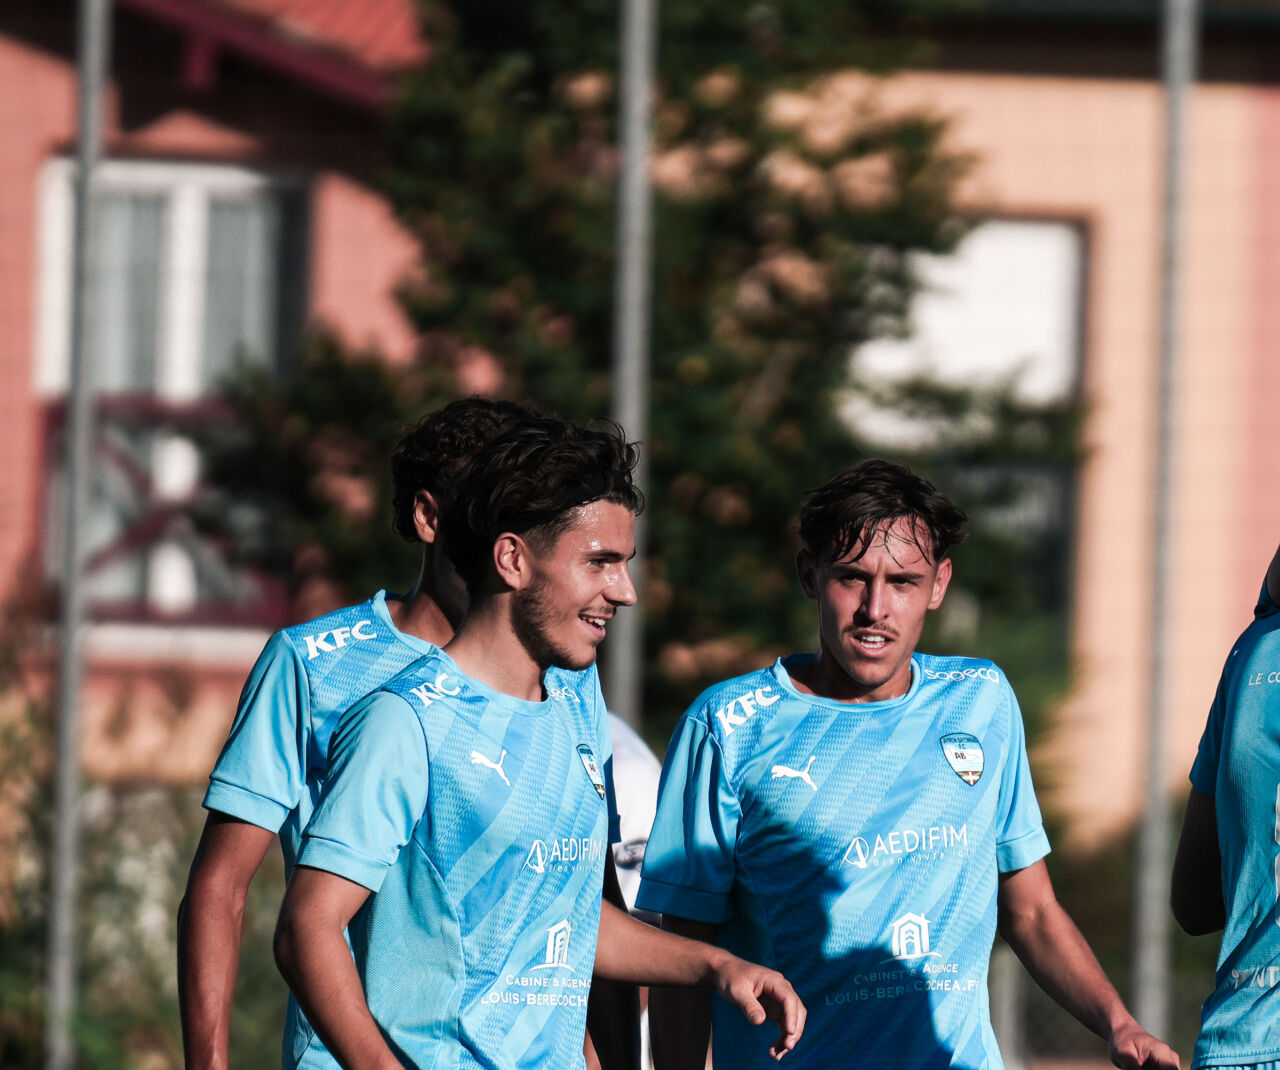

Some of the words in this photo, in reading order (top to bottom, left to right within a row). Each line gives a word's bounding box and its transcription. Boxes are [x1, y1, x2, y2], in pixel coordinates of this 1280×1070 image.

[303, 620, 377, 661] KFC
[1248, 673, 1264, 687] LE
[714, 685, 781, 737] KFC
[550, 838, 602, 862] AEDIFIM
[872, 823, 969, 858] AEDIFIM
[481, 991, 588, 1006] LOUIS-BERECOCH
